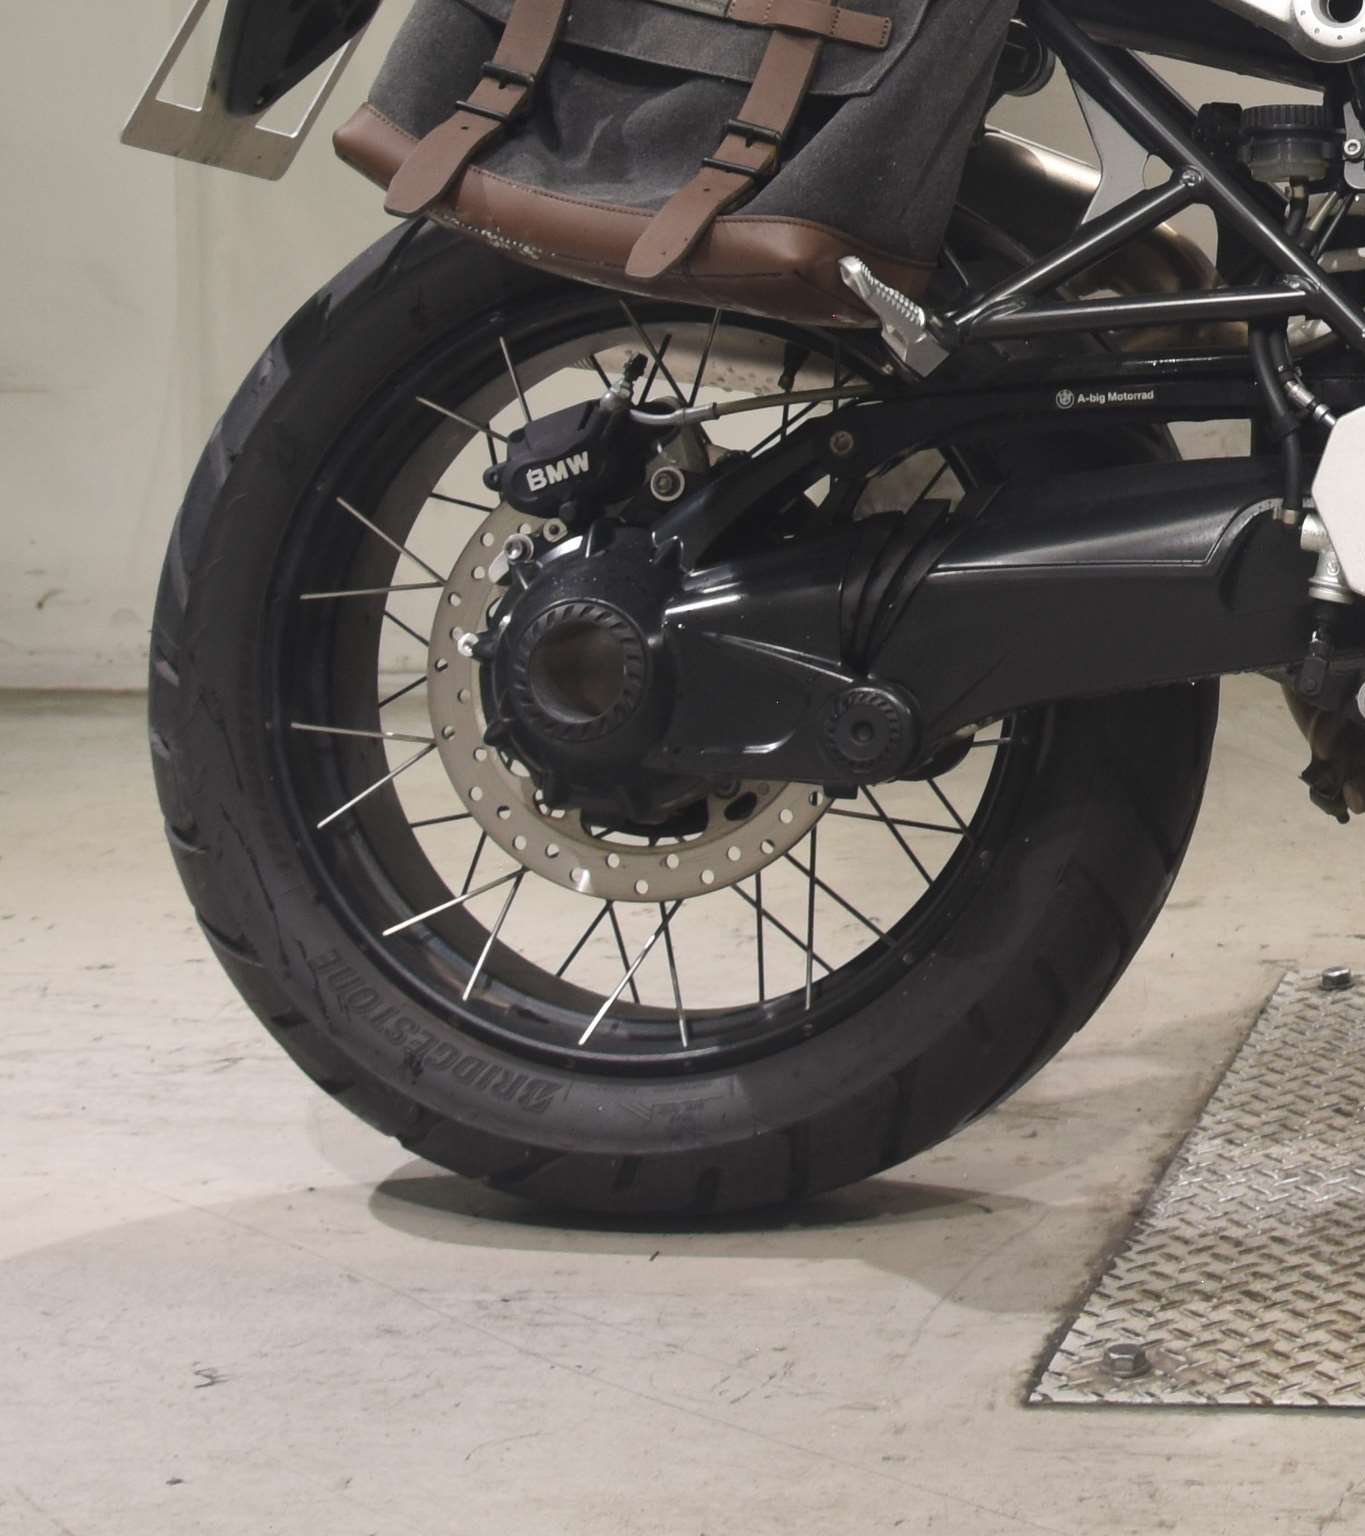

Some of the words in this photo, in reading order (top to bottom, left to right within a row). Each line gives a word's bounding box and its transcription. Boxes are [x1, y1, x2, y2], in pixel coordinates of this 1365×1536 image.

[1077, 392, 1105, 405] A-big
[1107, 389, 1155, 402] Motorrad
[526, 450, 590, 492] BMW
